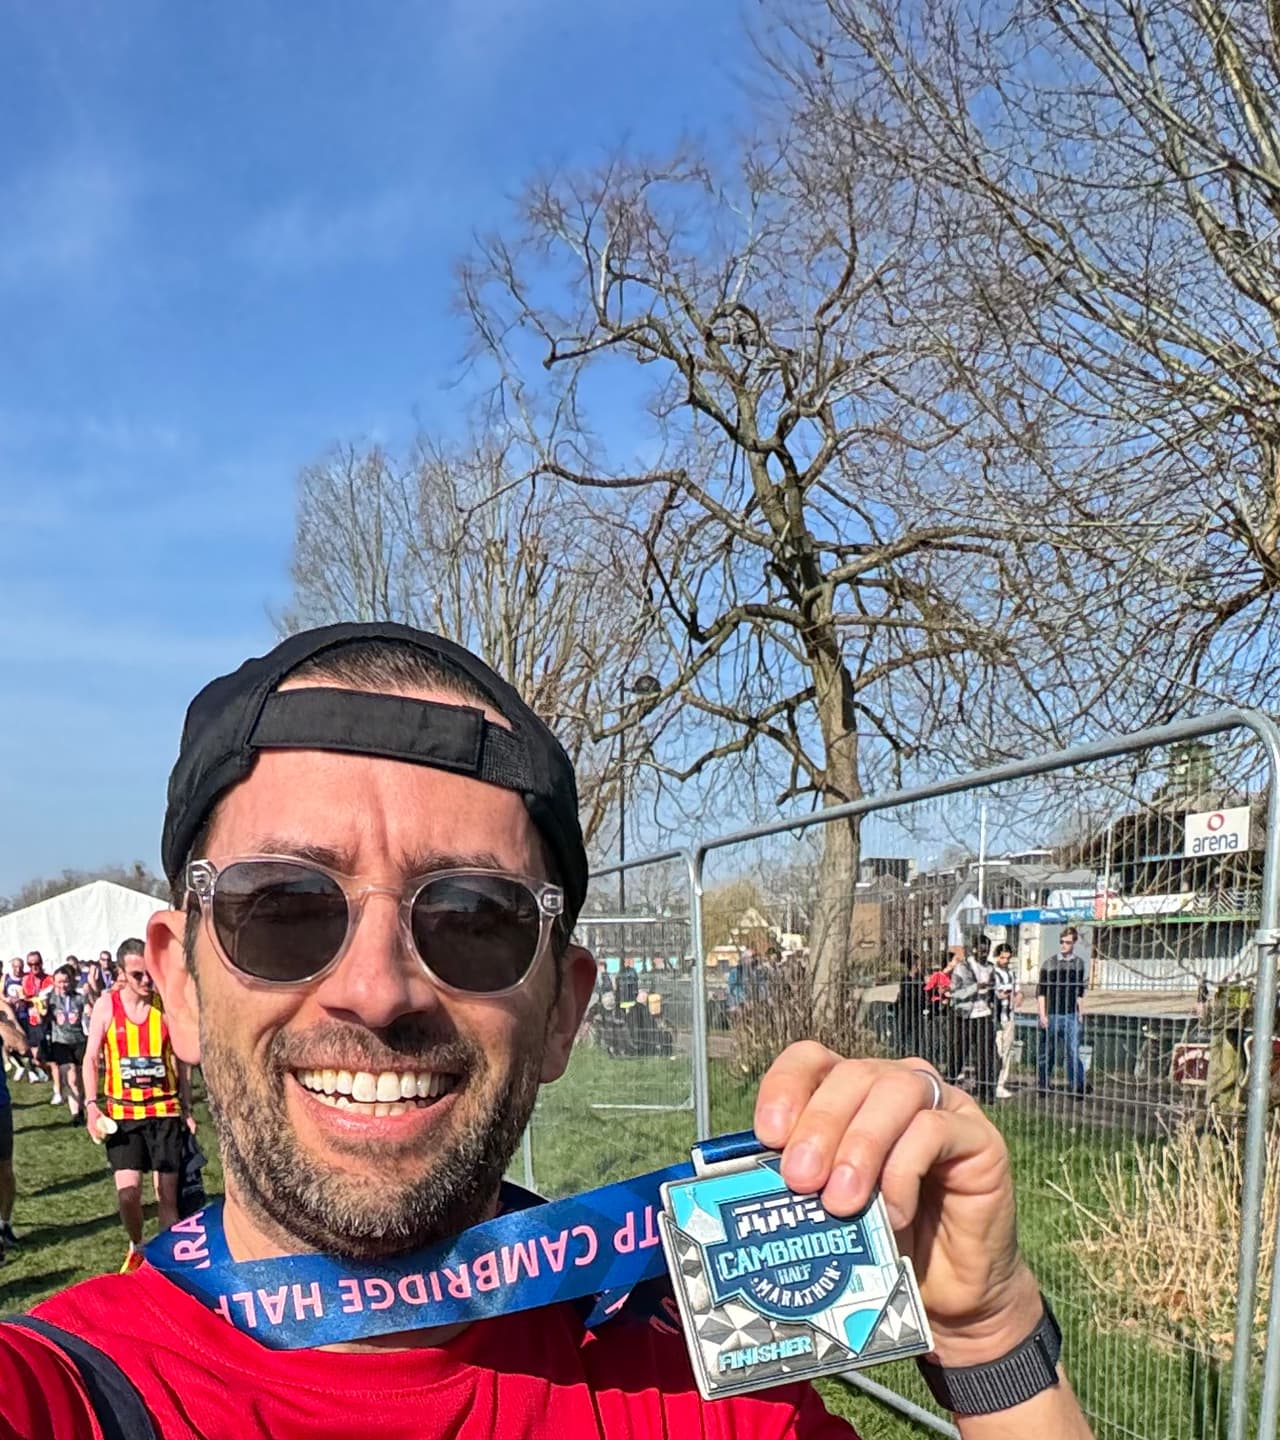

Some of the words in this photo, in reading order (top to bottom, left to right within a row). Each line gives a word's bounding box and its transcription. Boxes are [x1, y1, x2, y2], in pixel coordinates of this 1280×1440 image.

[1191, 831, 1239, 854] arena
[339, 1223, 599, 1315] CAMBRIDGE
[718, 1224, 864, 1281] CAMBRIDGE
[754, 1266, 841, 1308] MARATHON
[774, 1261, 813, 1286] HALF
[719, 1335, 814, 1372] FINISHER
